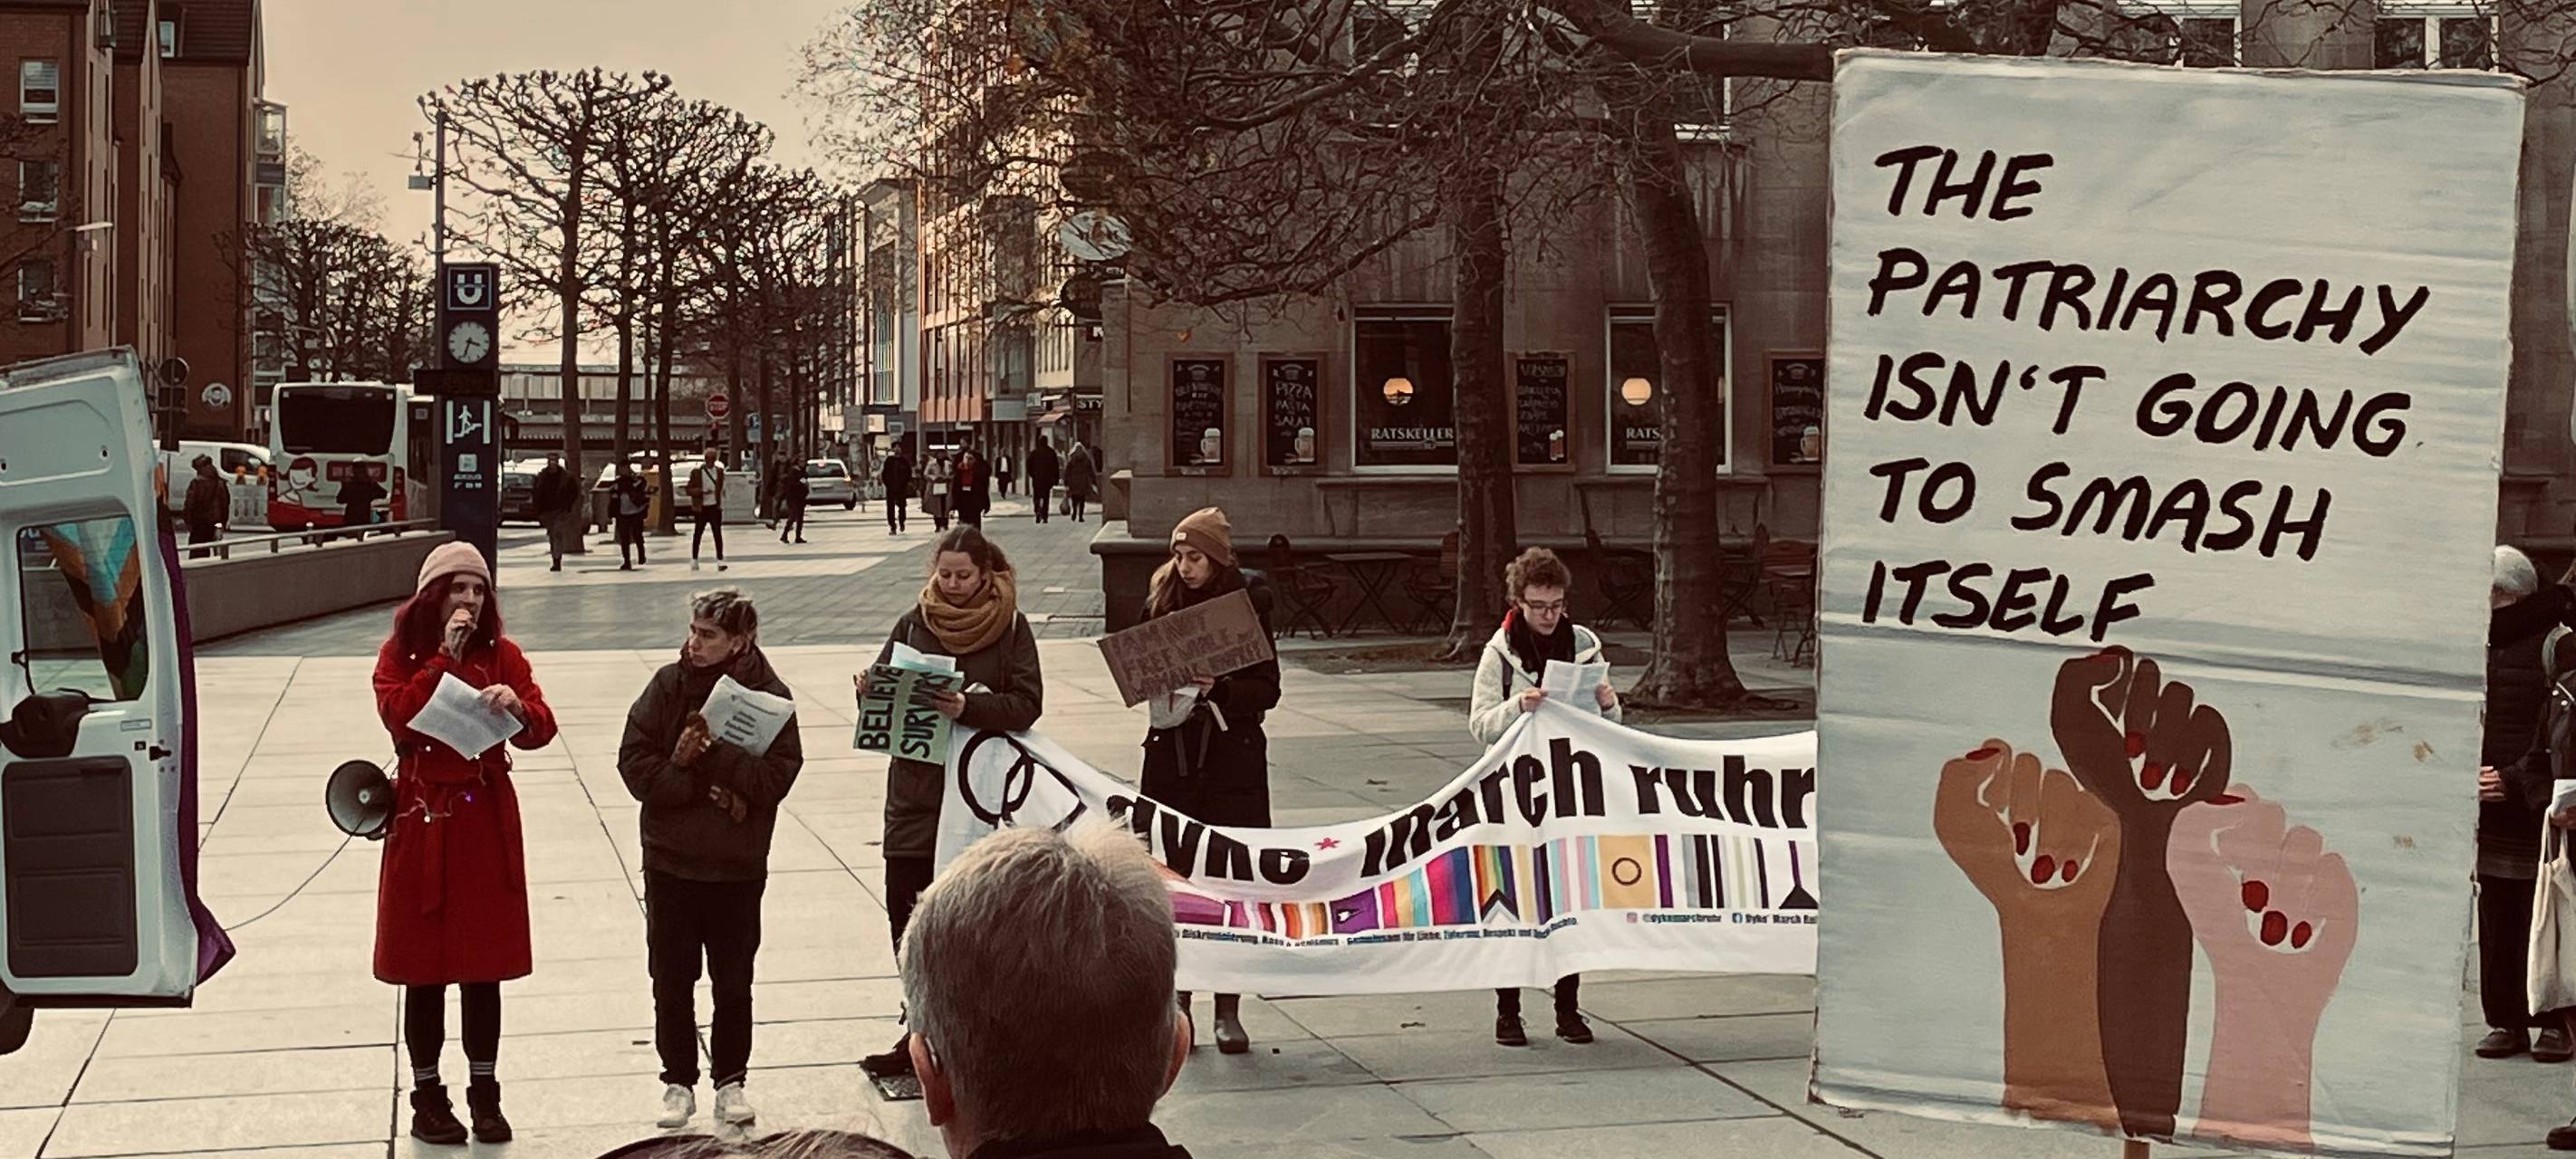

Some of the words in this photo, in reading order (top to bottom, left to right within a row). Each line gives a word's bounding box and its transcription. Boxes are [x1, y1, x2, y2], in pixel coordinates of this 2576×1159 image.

[1874, 145, 2054, 222] THE
[1867, 247, 2430, 356] PATRIARCHY
[1275, 382, 1312, 398] PIZZA
[1864, 351, 2107, 435] ISN'T
[2136, 372, 2411, 457] GOING
[1370, 427, 1454, 440] RATSKELLER
[1870, 456, 1976, 523] TO
[2010, 461, 2332, 561] SMASH
[1861, 560, 2155, 643] ITSELF
[858, 666, 905, 750] BELIEVE
[1360, 738, 1605, 878] march
[1628, 755, 1815, 829] ruhr
